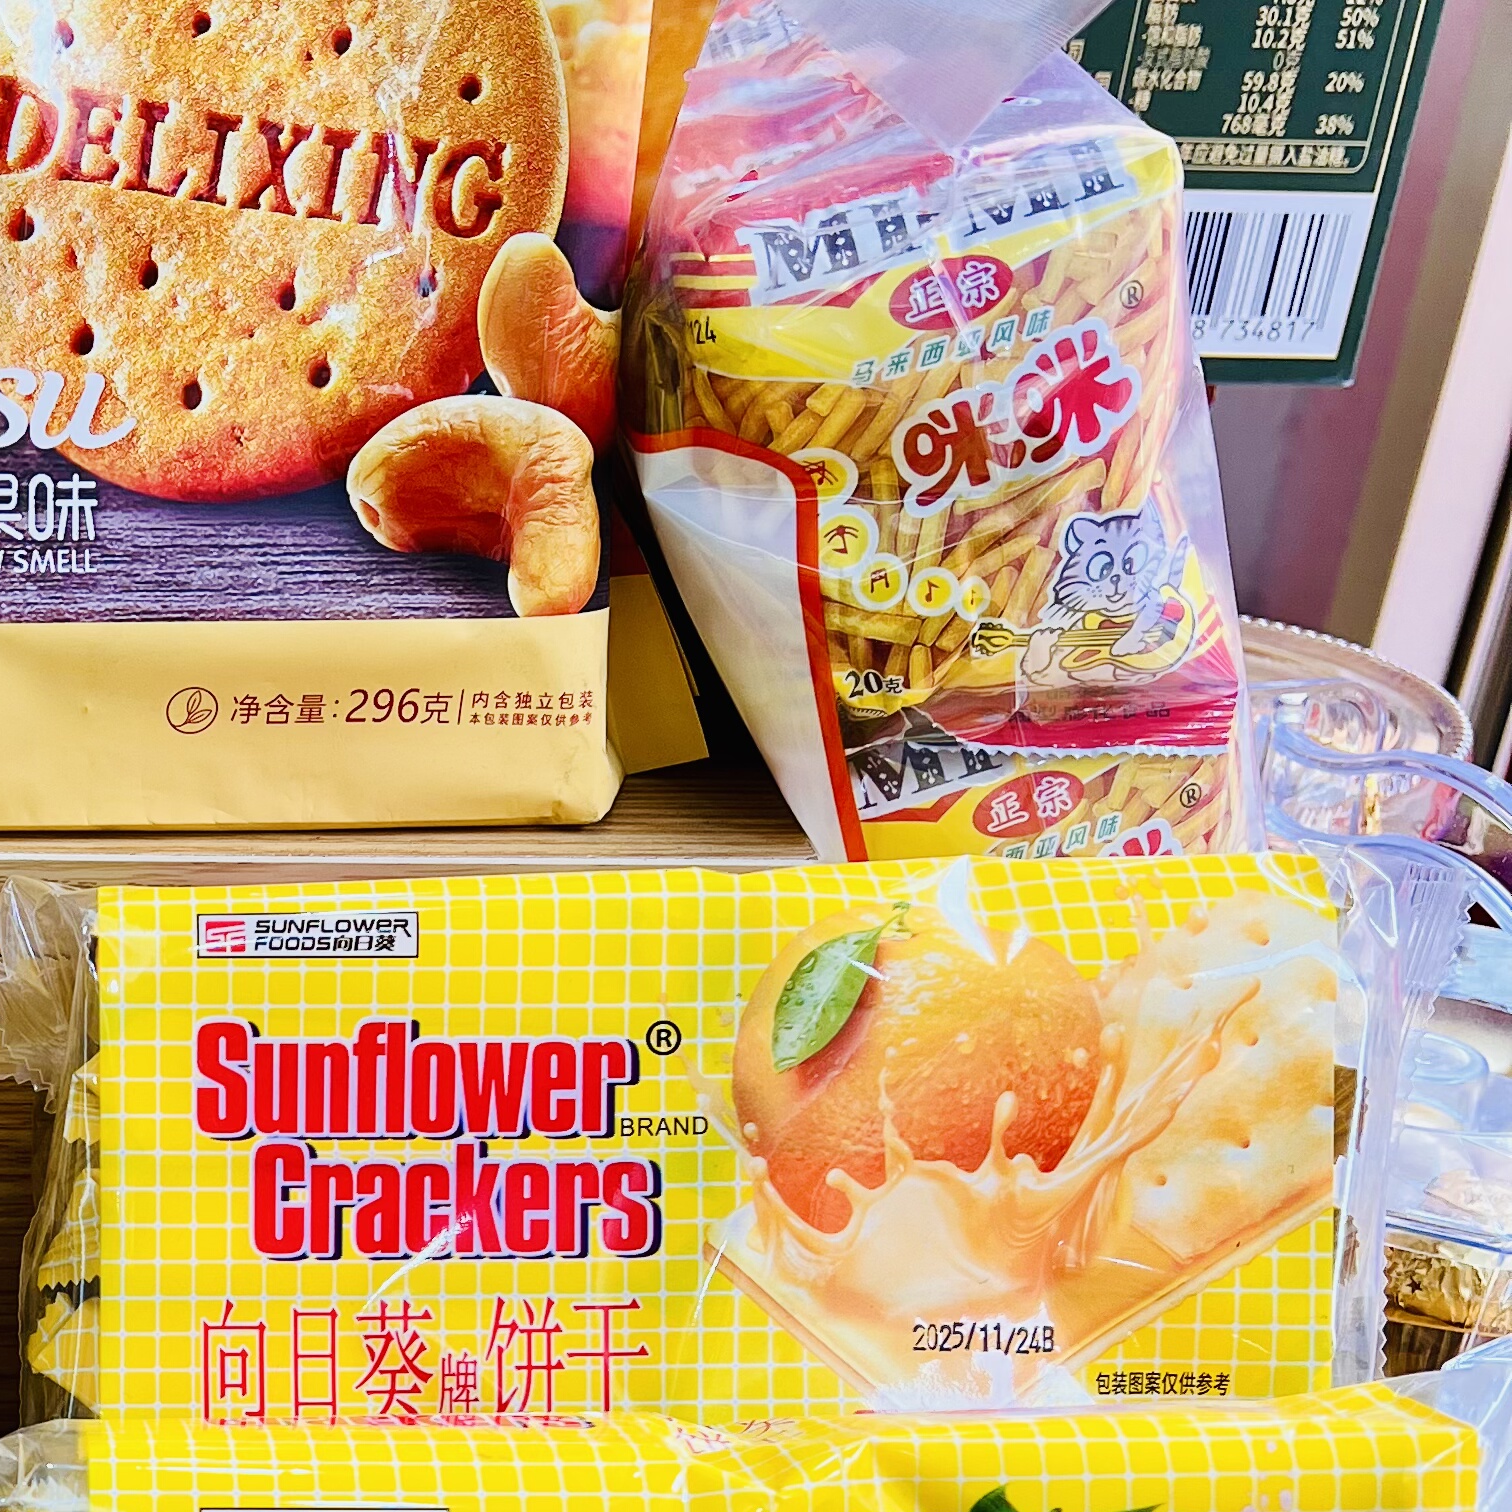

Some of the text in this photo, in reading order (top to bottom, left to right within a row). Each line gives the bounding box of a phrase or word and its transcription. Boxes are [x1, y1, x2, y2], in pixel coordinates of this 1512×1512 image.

[1340, 6, 1381, 28] 50%
[1335, 27, 1375, 50] 51%
[1325, 71, 1365, 94] 20%
[1314, 114, 1355, 136] 38%
[905, 261, 999, 322] 正宗
[1220, 320, 1316, 342] 734817
[13, 549, 98, 574] SMELL
[844, 670, 904, 698] 20克
[471, 690, 594, 710] 内含独立包装
[988, 776, 1073, 834] 正宗
[255, 919, 412, 937] SUNFLOWER
[195, 1016, 640, 1141] Sunflower
[620, 1116, 709, 1137] BRAND
[251, 1138, 662, 1261] Crackers
[912, 1322, 1055, 1356] 2025/11/24B
[202, 1295, 649, 1418] 向日葵牌饼干
[1095, 1371, 1231, 1396] 包装图案仅供参考
